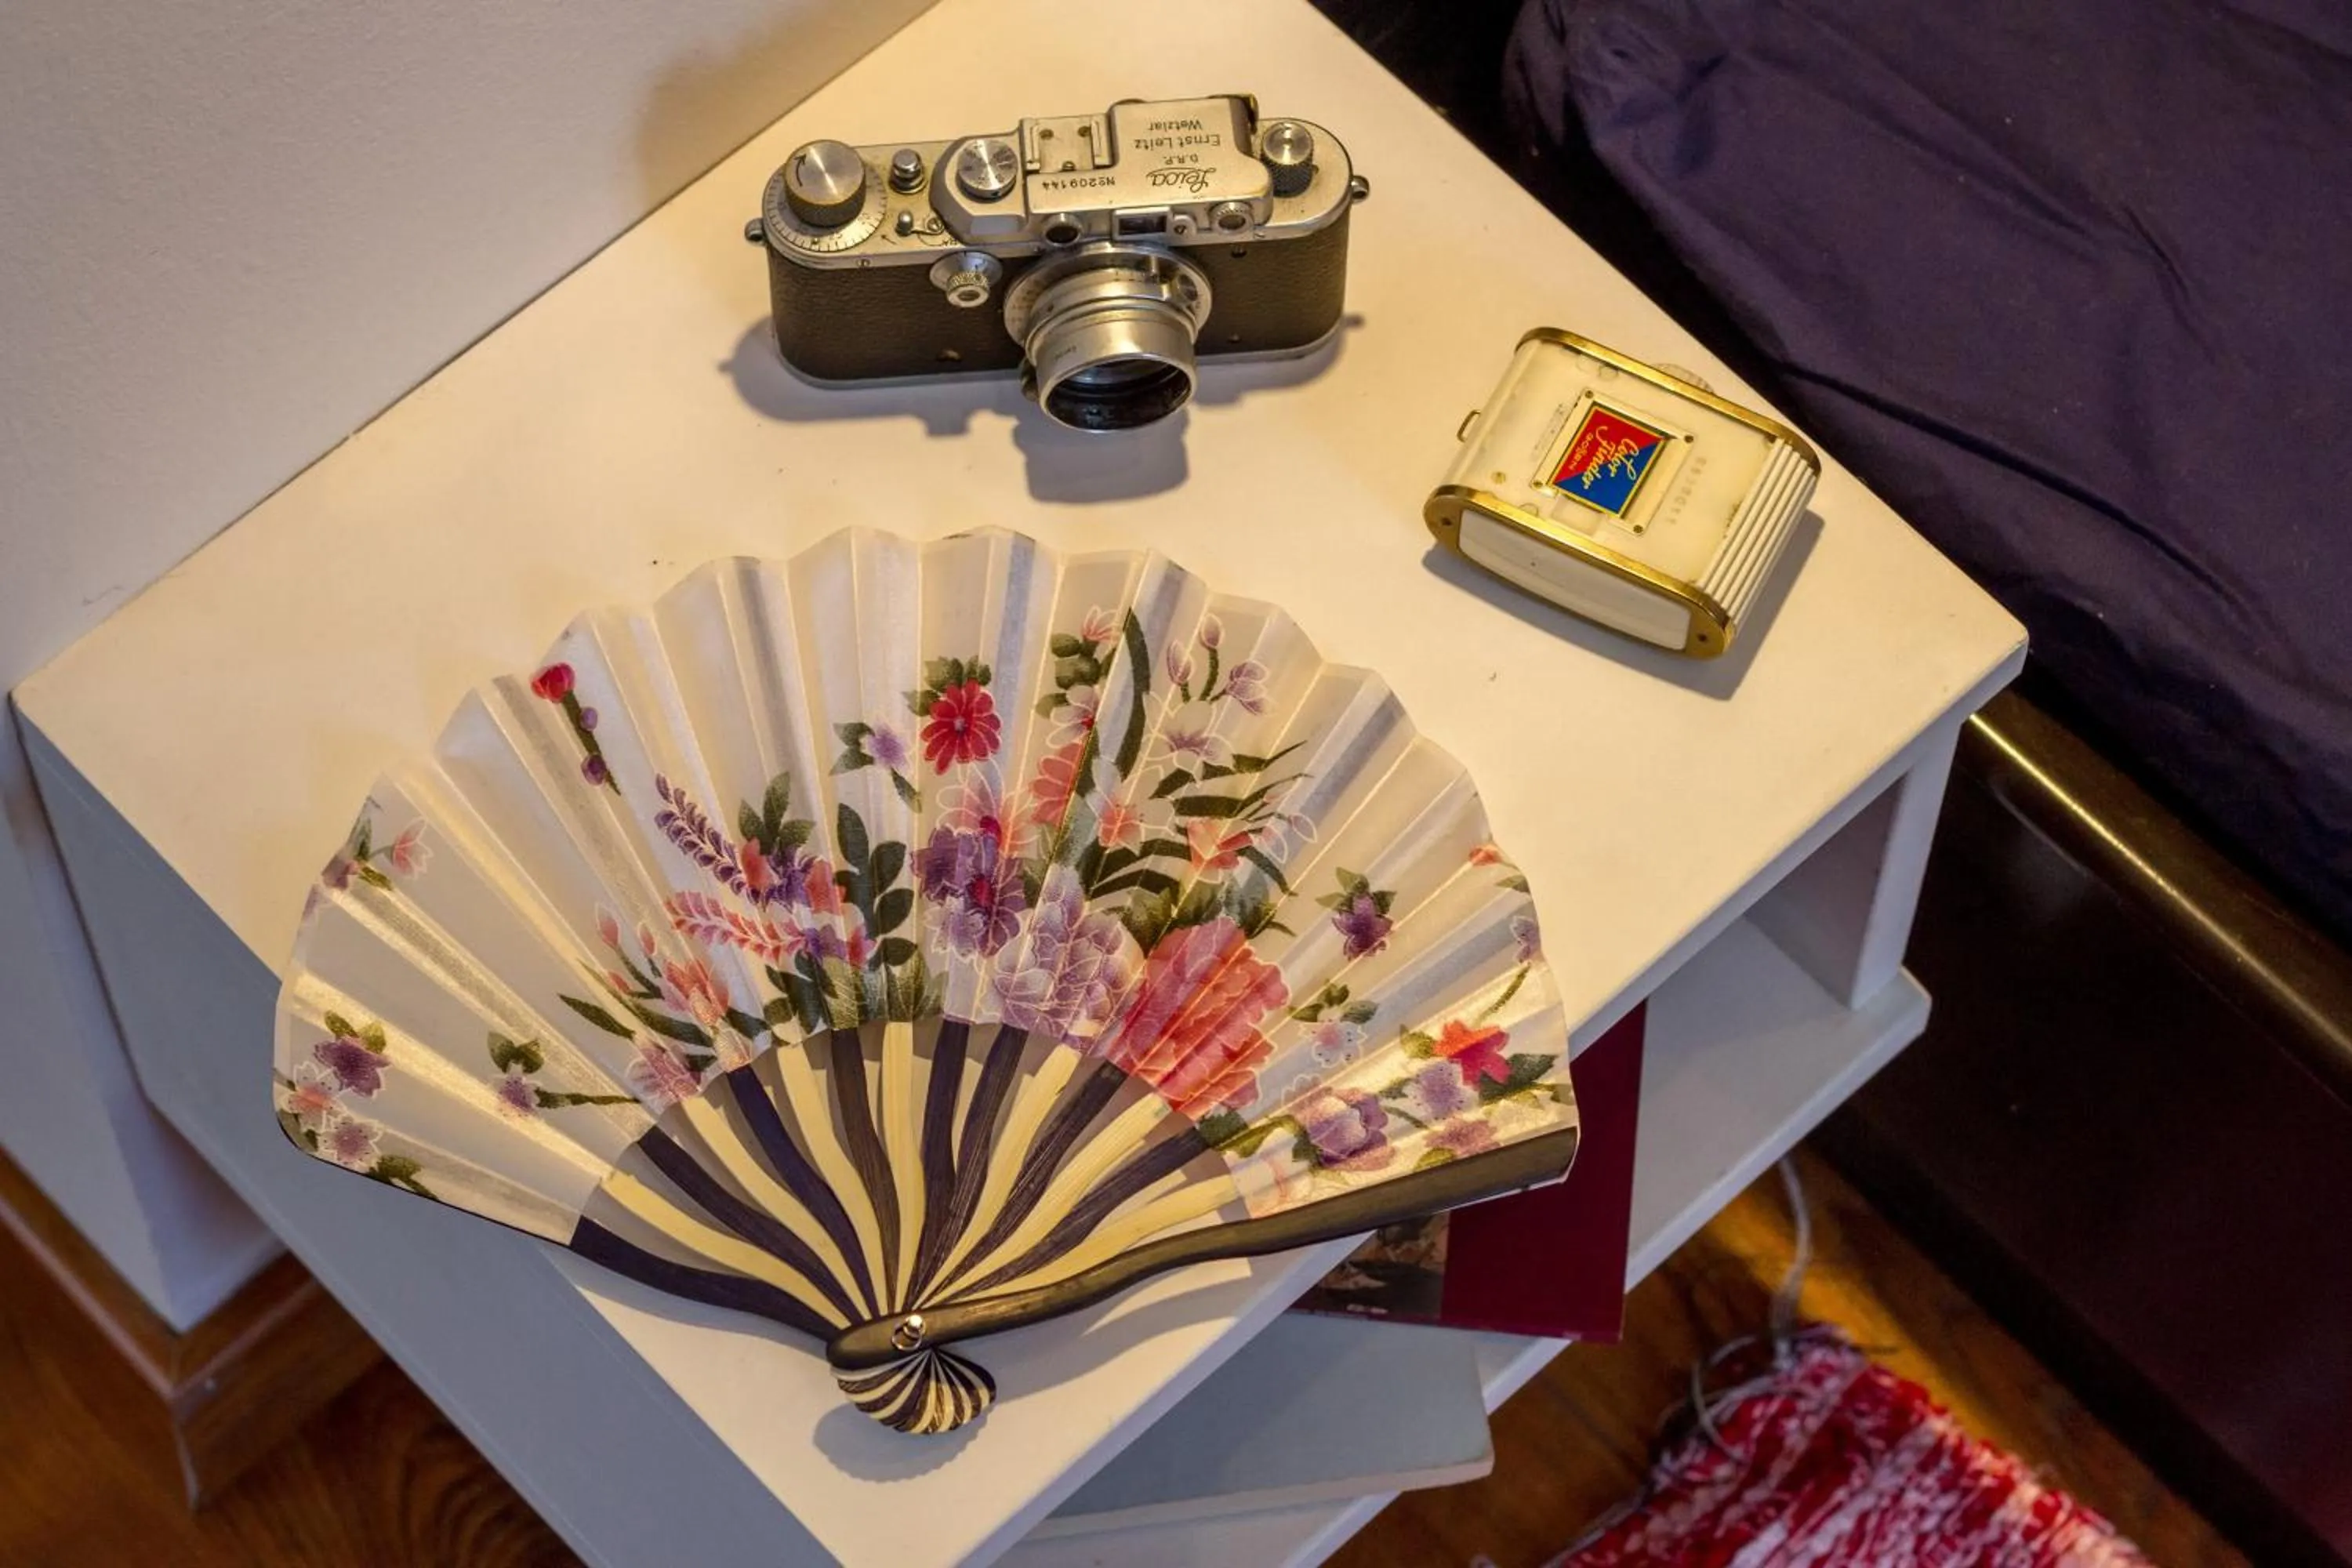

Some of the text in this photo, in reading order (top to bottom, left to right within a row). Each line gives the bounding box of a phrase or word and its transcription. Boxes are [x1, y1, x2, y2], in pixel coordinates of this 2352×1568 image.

[1148, 119, 1203, 131] Wetzlar
[1134, 134, 1221, 148] Ernst Leitz
[1146, 167, 1216, 193] Leica
[1582, 426, 1616, 490] Finder
[1607, 437, 1639, 481] Color
